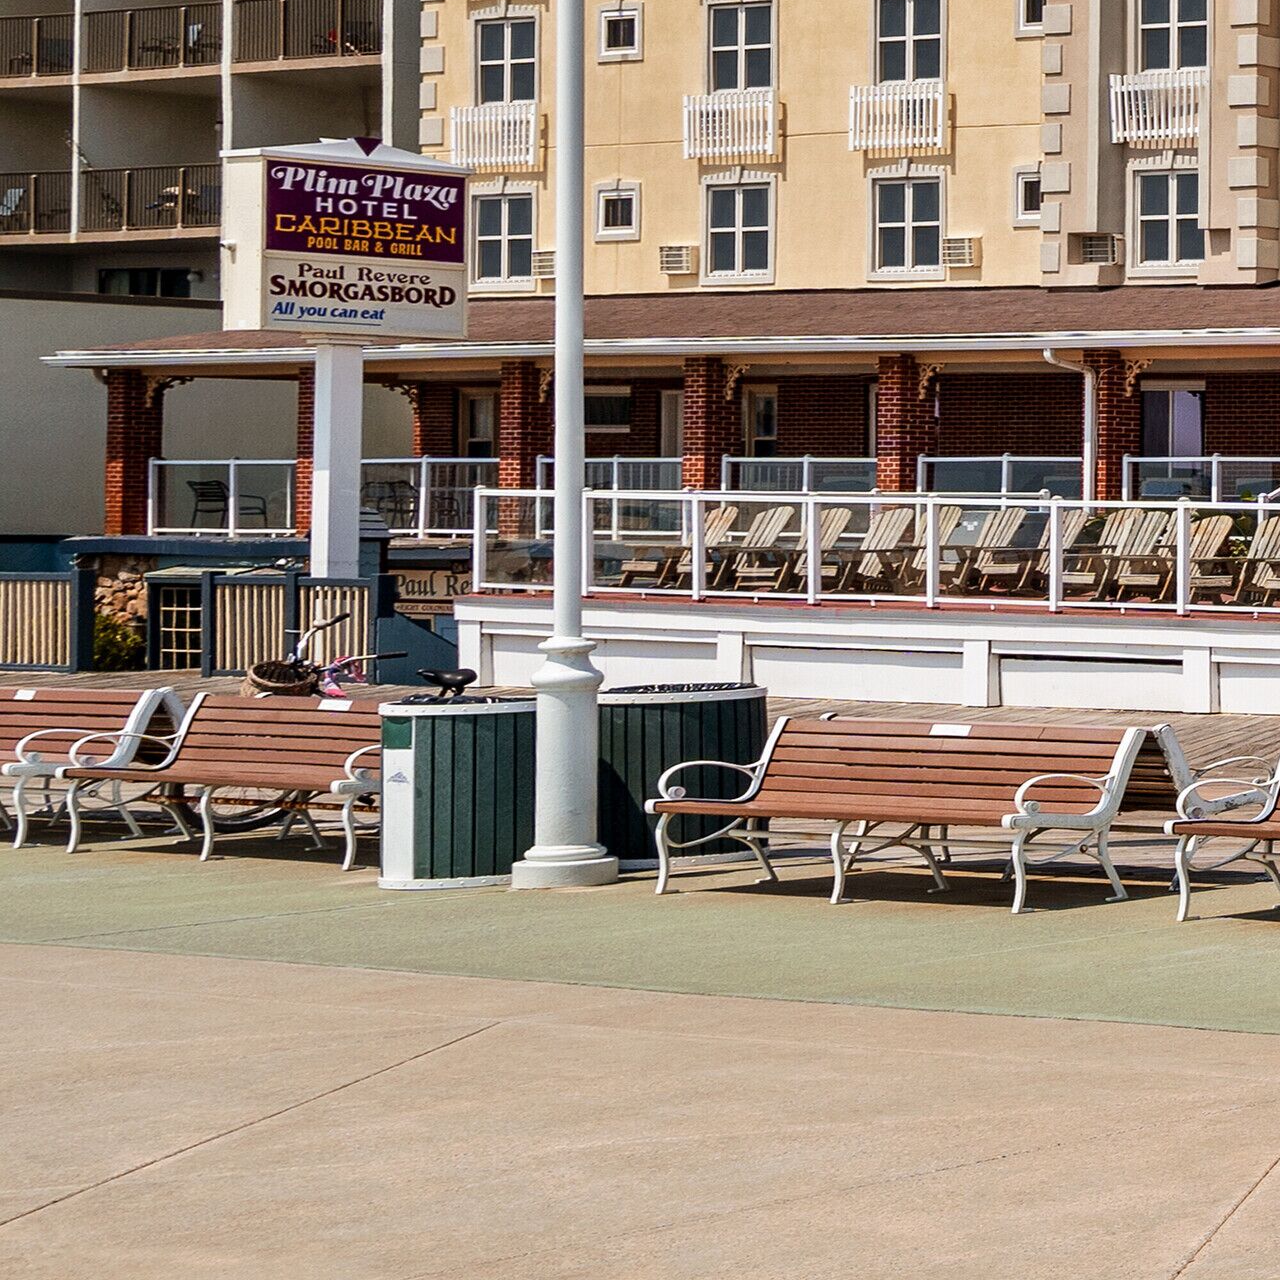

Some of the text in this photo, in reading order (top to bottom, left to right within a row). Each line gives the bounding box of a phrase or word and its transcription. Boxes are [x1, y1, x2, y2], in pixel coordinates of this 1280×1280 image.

[271, 166, 458, 210] Plim Plaza
[316, 197, 418, 220] HOTEL
[275, 214, 457, 244] CARIBBEAN
[307, 236, 423, 256] POOL BAR & GRILL
[298, 263, 431, 285] Paul Revere
[269, 274, 456, 308] SMORGASBORD
[272, 301, 385, 320] All you can eat
[397, 572, 437, 596] Paul
